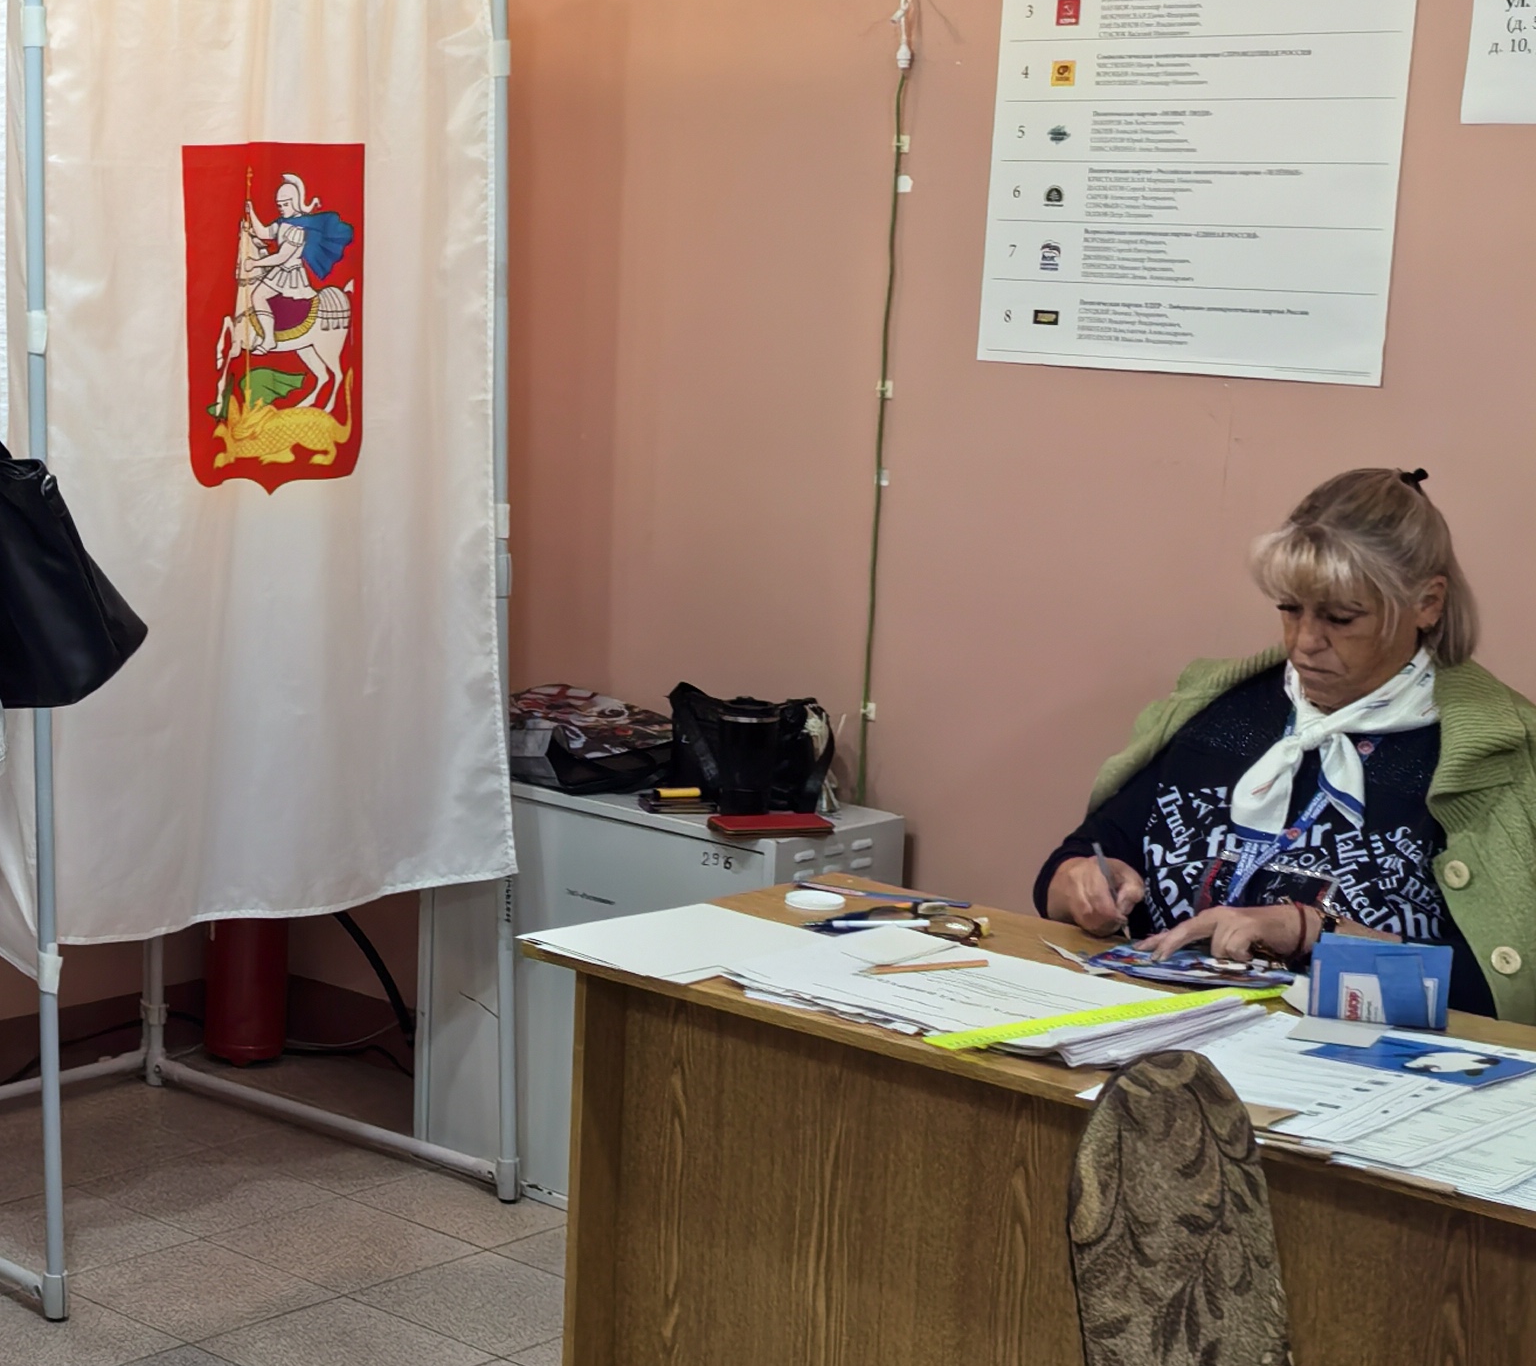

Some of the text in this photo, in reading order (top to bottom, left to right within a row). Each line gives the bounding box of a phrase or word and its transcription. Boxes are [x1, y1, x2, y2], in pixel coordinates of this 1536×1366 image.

[1025, 5, 1034, 18] 3
[1506, 16, 1527, 34] (д.
[1488, 38, 1531, 56] д. 10,
[1021, 66, 1029, 80] 4
[1017, 125, 1025, 139] 5
[1012, 185, 1021, 198] 6
[1008, 244, 1017, 258] 7
[1003, 310, 1011, 323] 8
